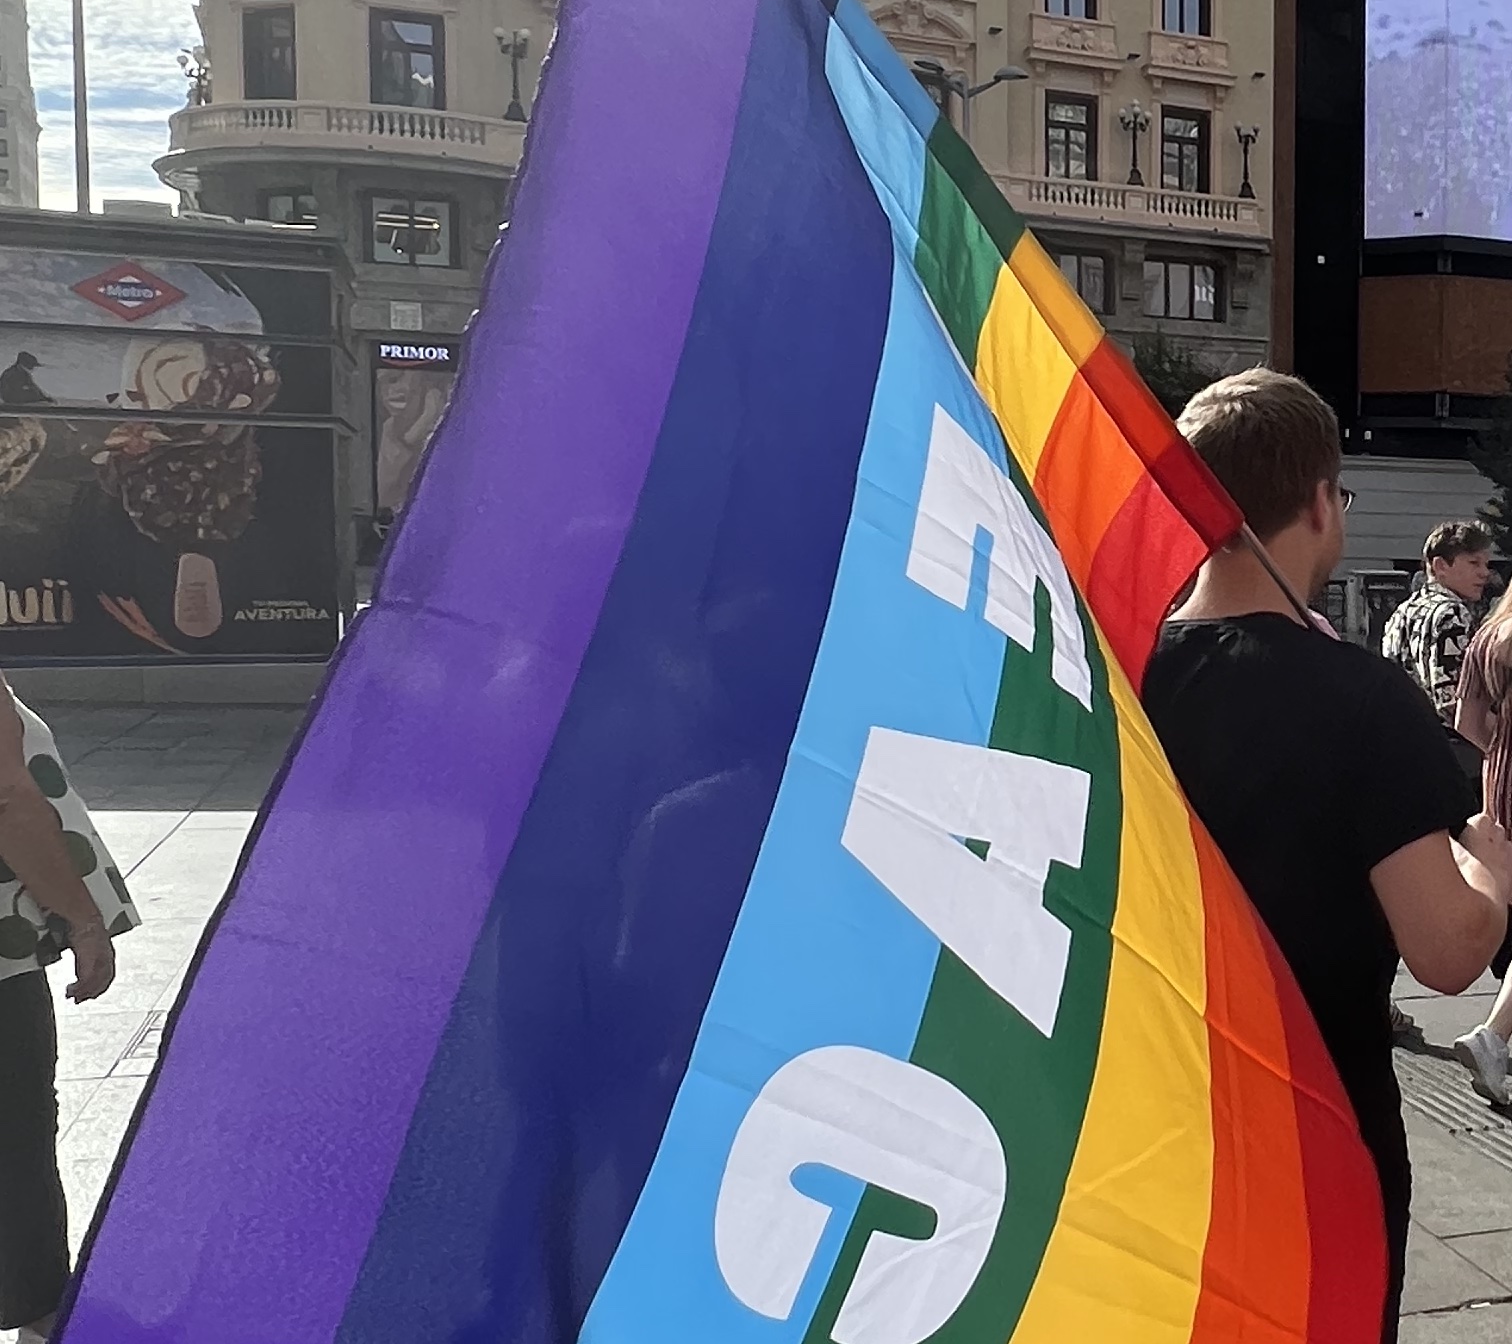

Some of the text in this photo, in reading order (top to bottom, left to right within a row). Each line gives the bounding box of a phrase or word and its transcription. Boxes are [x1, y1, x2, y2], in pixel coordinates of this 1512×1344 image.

[106, 285, 154, 299] Metro
[380, 344, 449, 360] PRIMOR
[234, 607, 331, 621] AVENTURA
